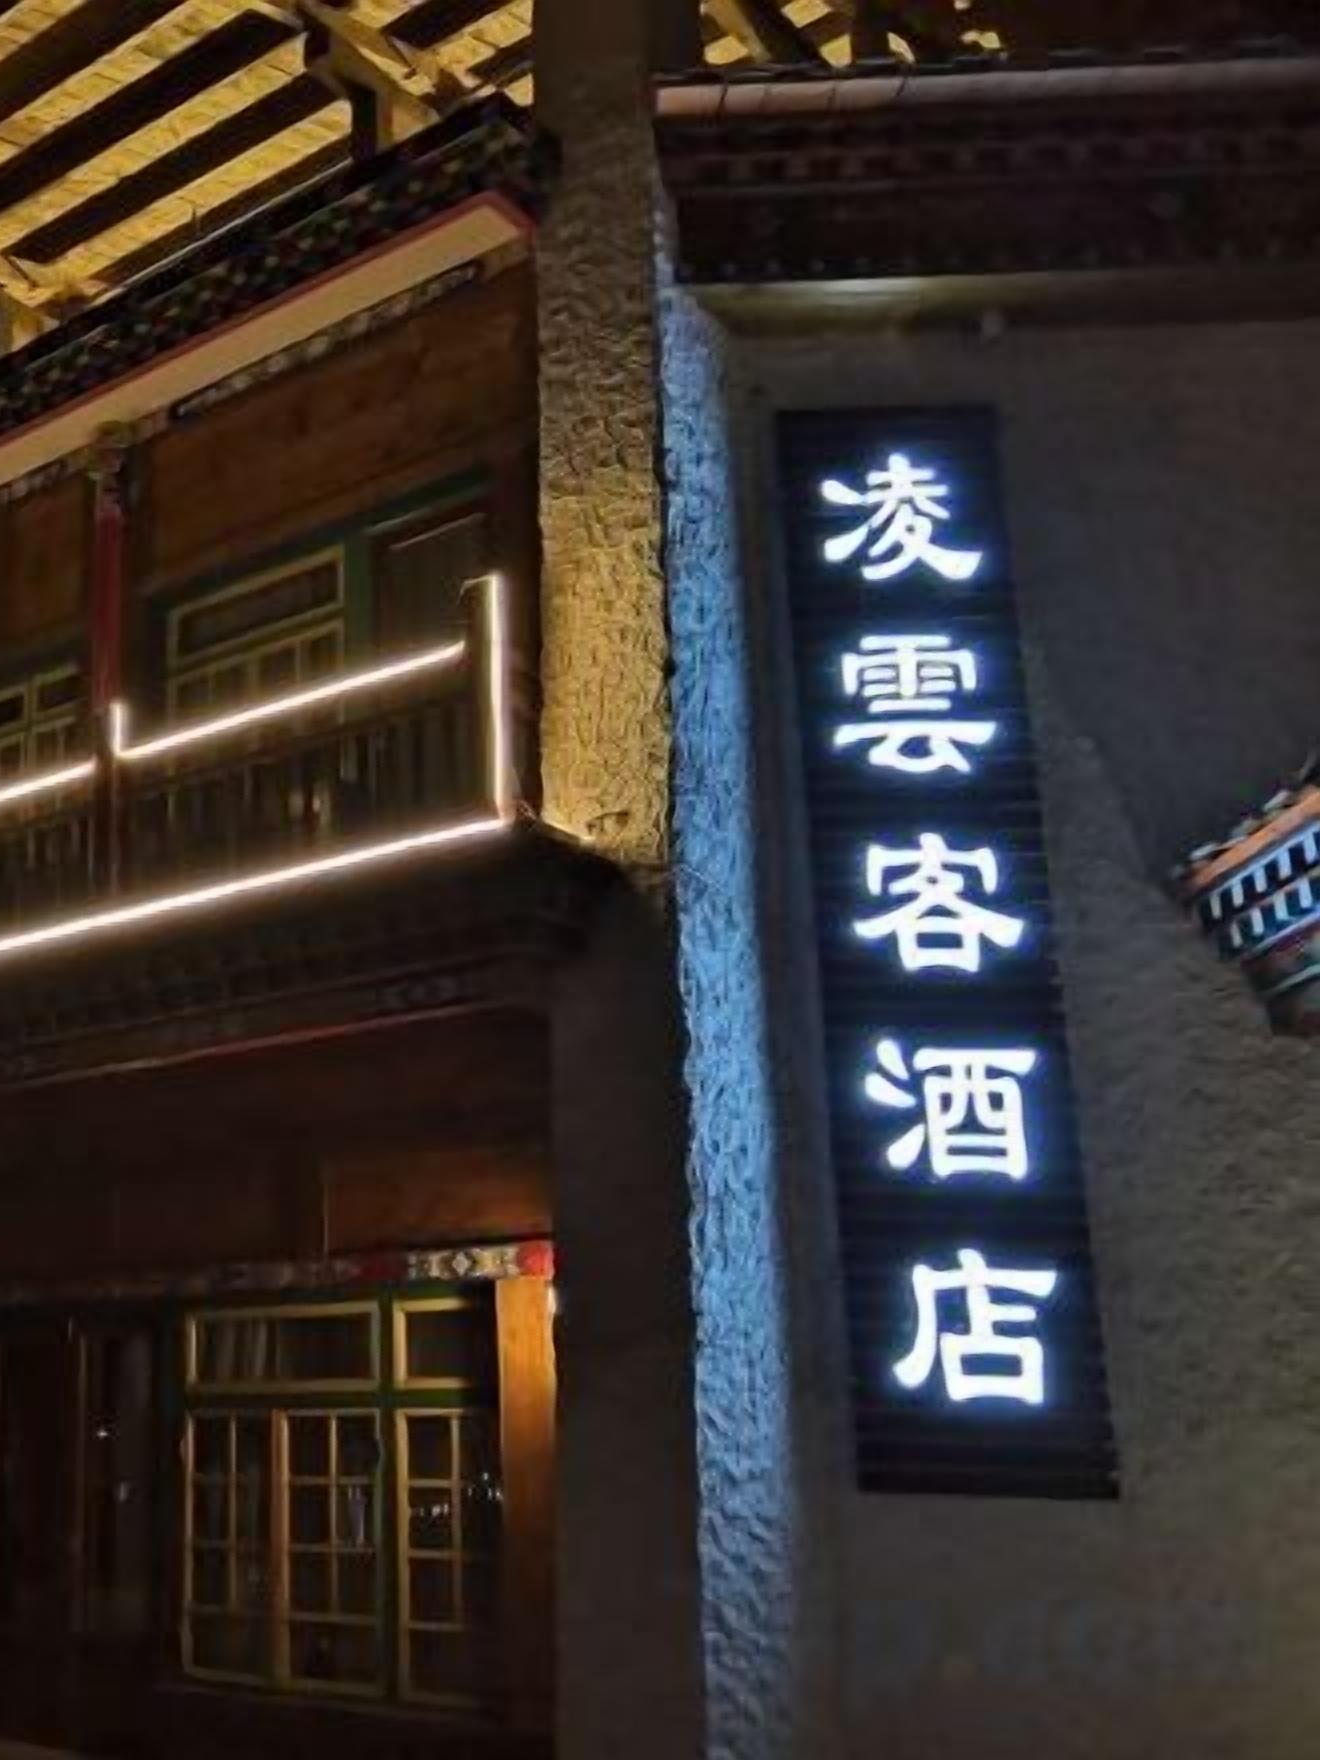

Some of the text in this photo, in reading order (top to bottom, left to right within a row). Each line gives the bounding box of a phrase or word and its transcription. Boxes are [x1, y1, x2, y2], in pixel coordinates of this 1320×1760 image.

[820, 454, 1057, 1405] 凌雲客酒店
